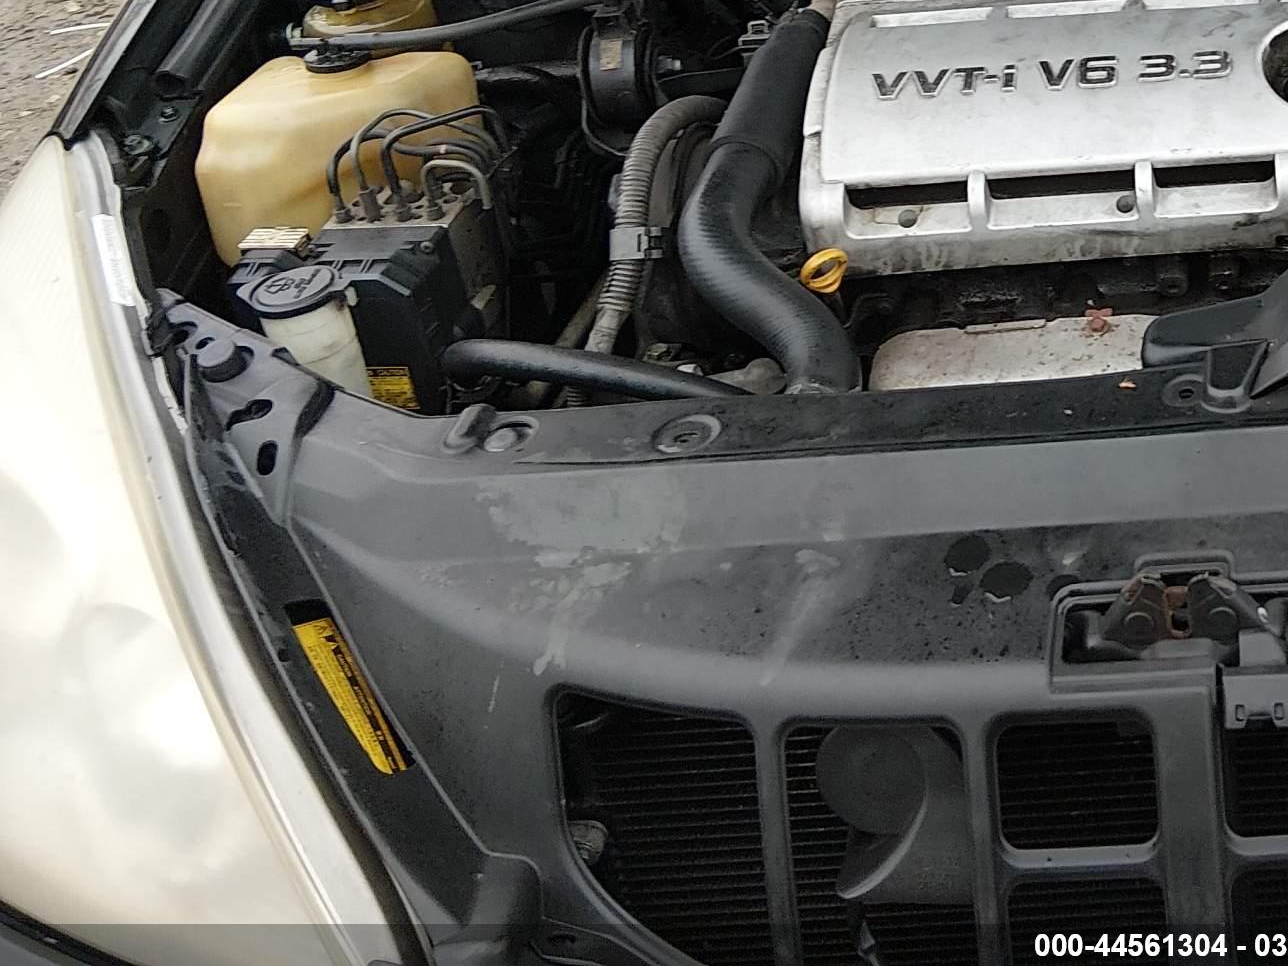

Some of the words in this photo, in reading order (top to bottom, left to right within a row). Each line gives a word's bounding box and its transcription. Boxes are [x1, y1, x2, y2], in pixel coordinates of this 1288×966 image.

[871, 64, 1018, 101] VVT-i
[1039, 56, 1119, 92] V6
[1138, 50, 1233, 83] 3.3
